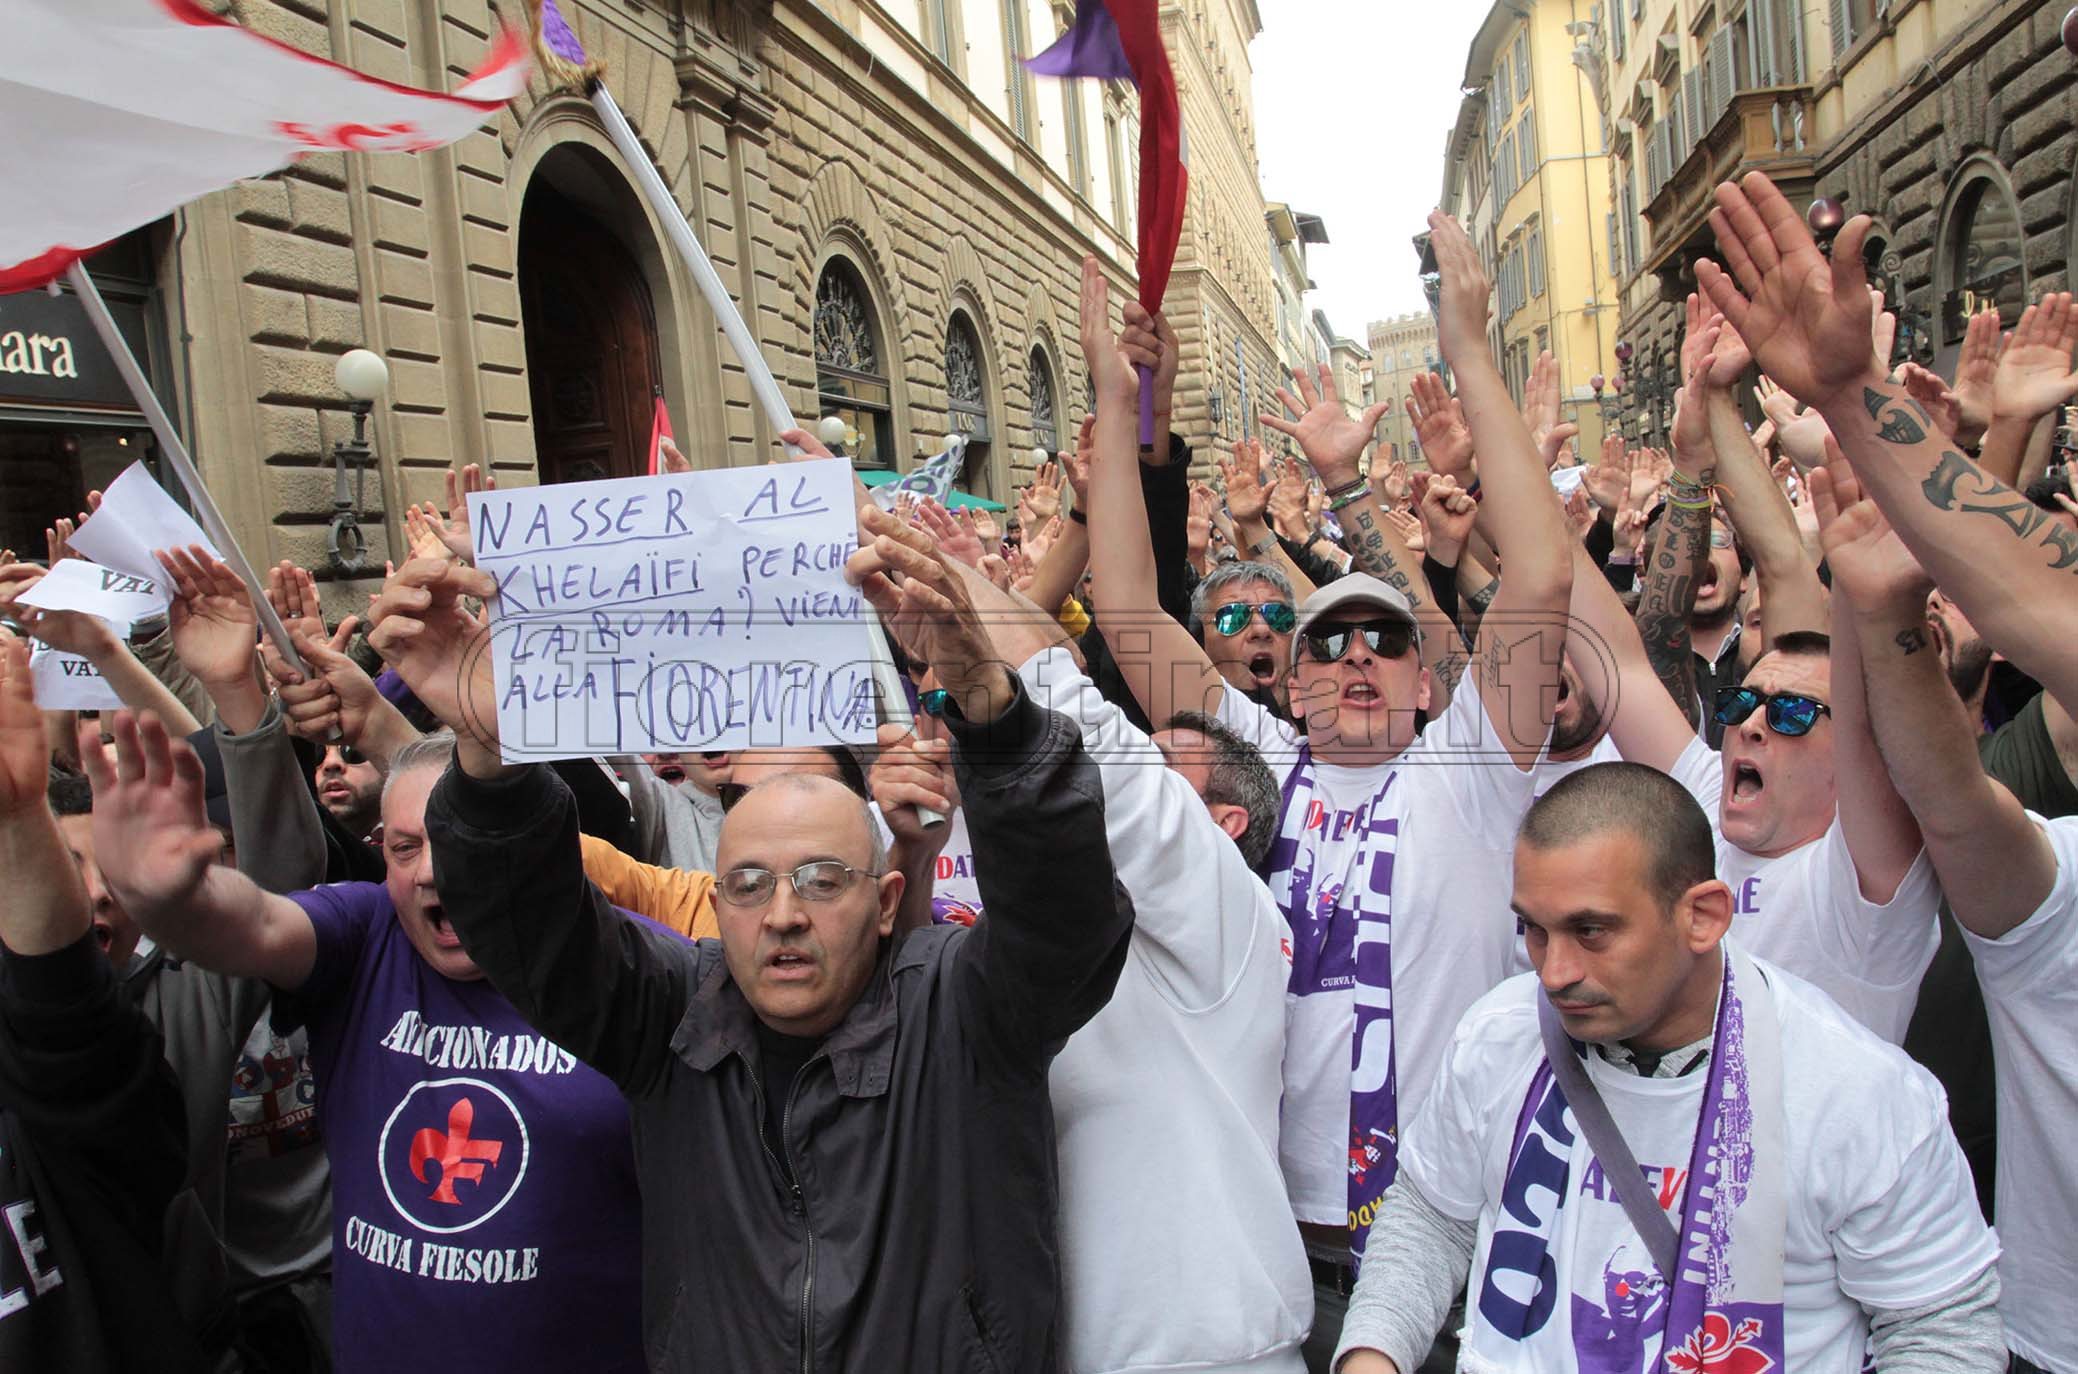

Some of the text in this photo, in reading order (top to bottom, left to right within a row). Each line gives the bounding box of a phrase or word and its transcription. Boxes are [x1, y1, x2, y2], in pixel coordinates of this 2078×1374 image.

[0, 331, 79, 378] ara
[478, 476, 822, 553] NASSER AL
[510, 624, 564, 660] LA
[776, 585, 859, 627] VIENI
[502, 672, 597, 710] ALLA
[1320, 975, 1350, 988] CURVA
[345, 1215, 540, 1284] CURVA FIESOLE
